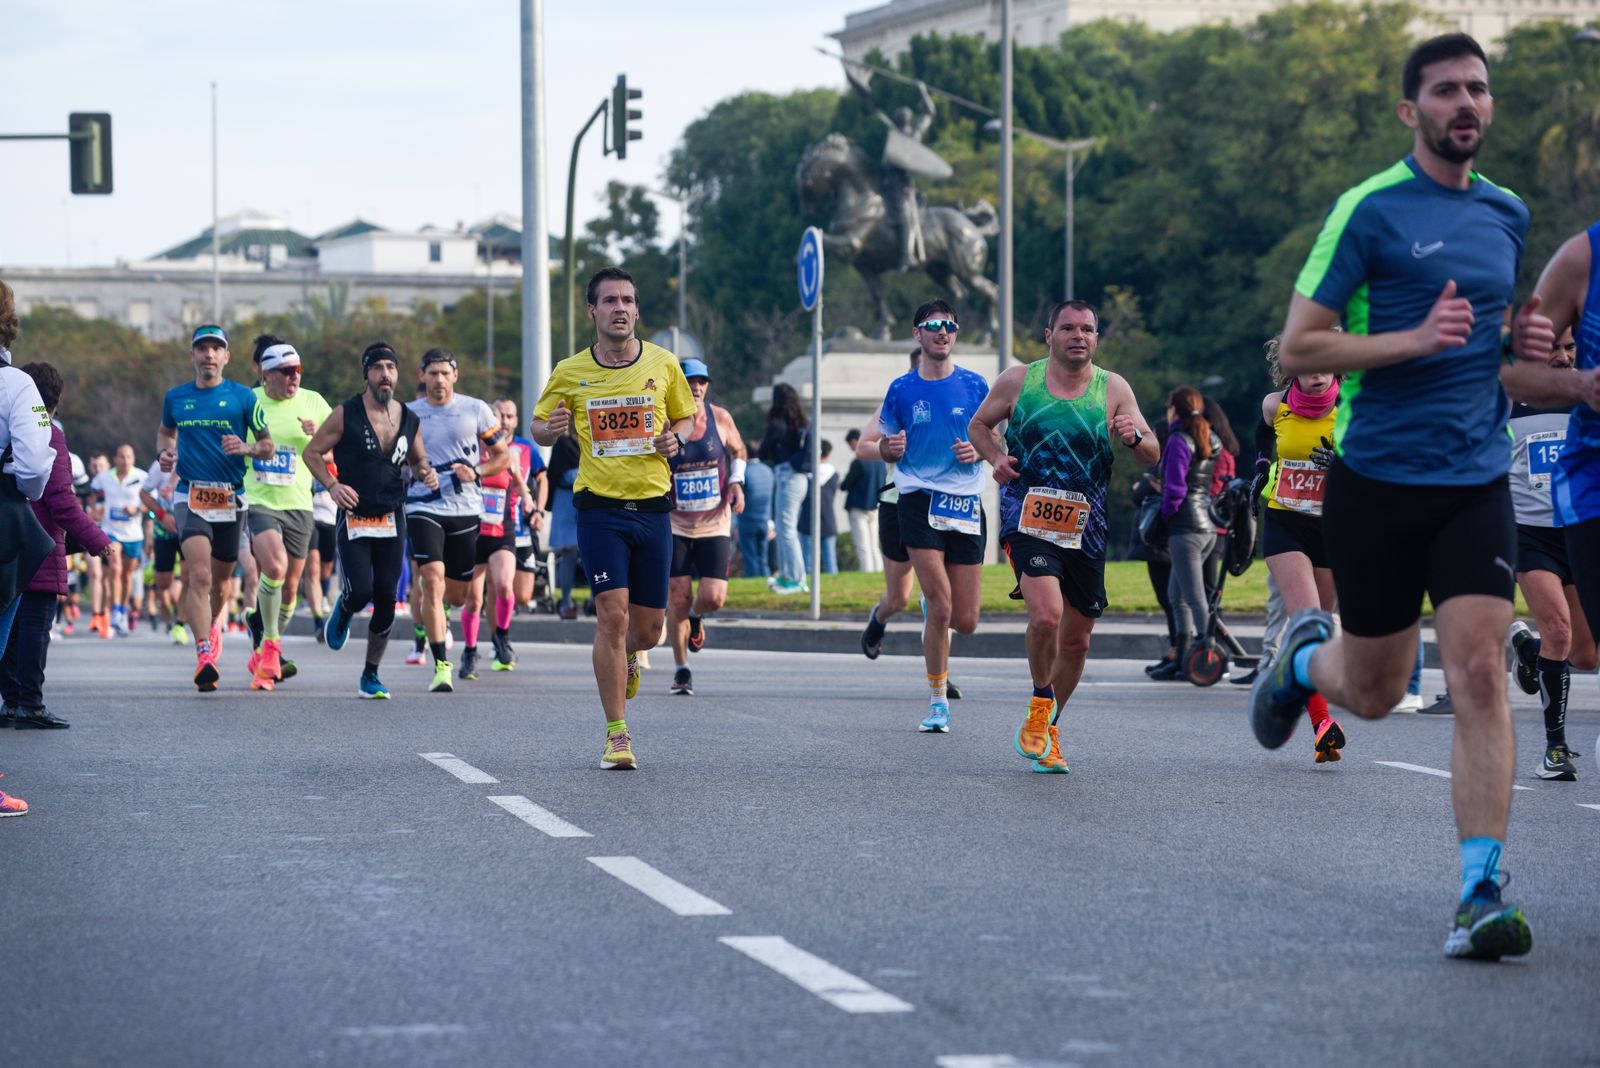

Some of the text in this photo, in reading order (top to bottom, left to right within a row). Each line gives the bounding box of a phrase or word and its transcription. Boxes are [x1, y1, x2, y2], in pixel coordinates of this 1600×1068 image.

[626, 396, 645, 405] SEVILLA
[598, 411, 640, 431] 3825
[1538, 444, 1566, 463] 15
[682, 479, 711, 494] 2804
[1287, 473, 1325, 492] 1247
[196, 491, 225, 503] 4328
[938, 494, 971, 513] 2198
[1065, 491, 1084, 501] SEVILLA
[1032, 500, 1075, 523] 3867
